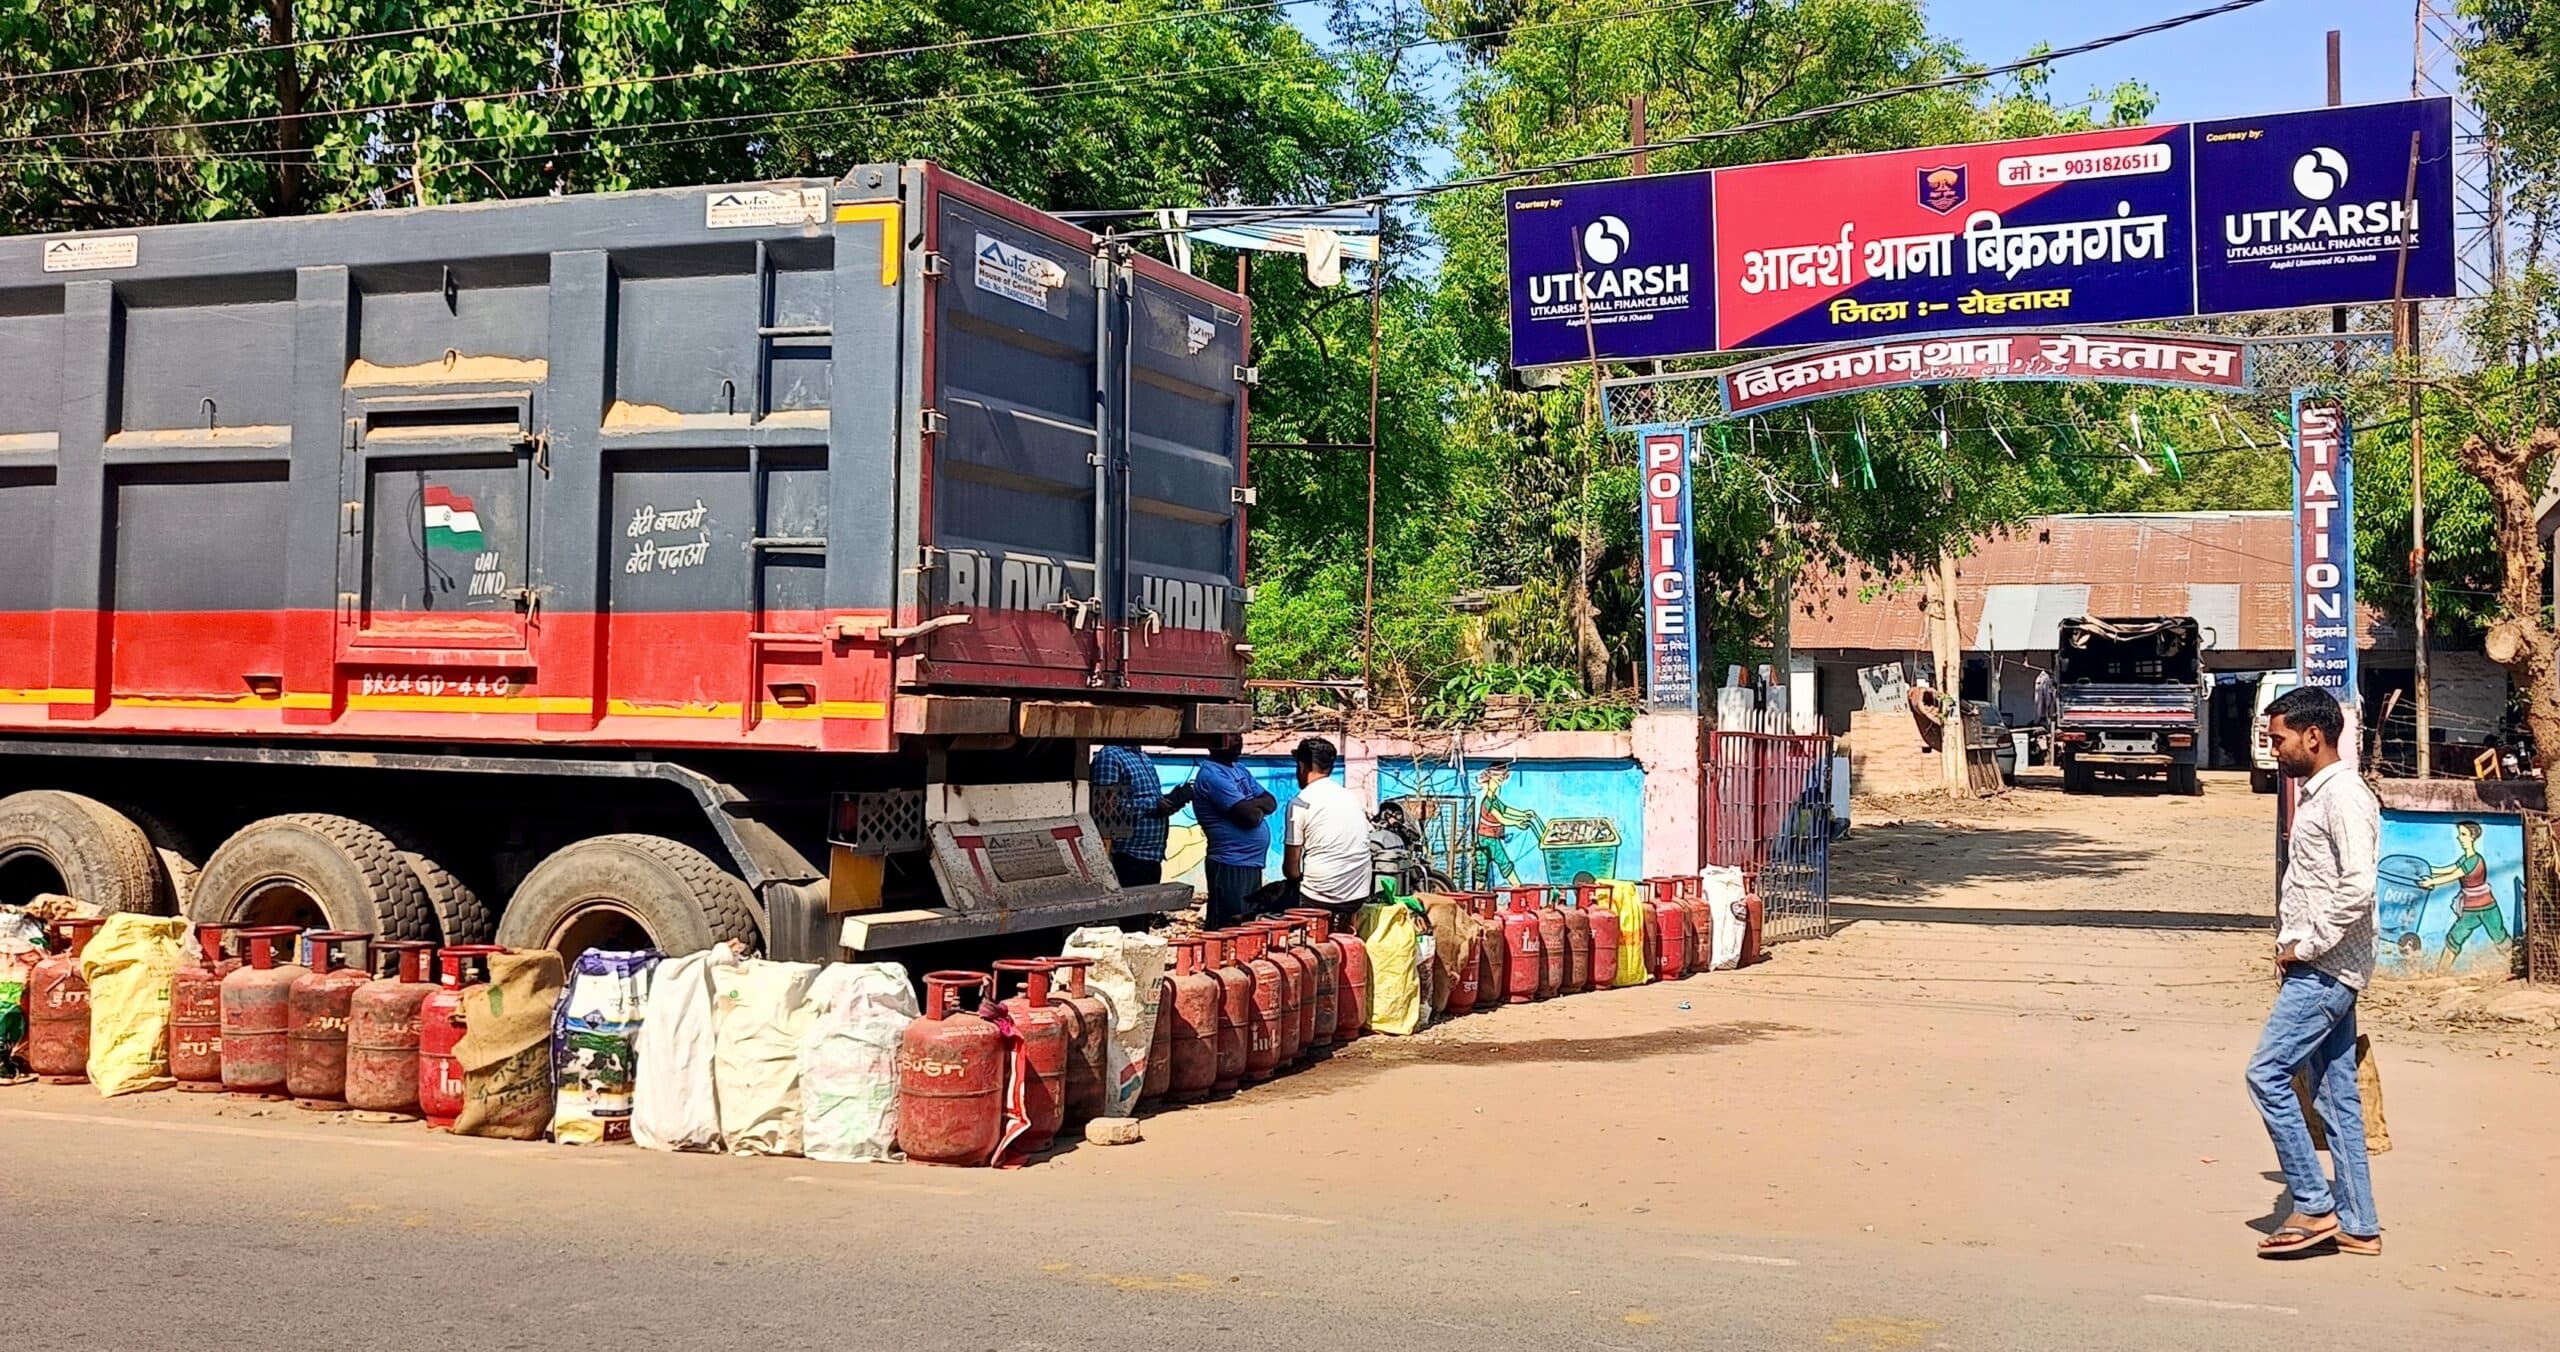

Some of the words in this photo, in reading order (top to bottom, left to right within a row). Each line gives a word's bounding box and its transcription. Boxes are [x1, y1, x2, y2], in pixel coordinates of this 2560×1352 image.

[2008, 155, 2033, 181] मो
[2064, 152, 2159, 177] 9031826511
[2225, 200, 2419, 245] UTKARSH
[980, 242, 1028, 273] Auto
[1740, 222, 1855, 294] आदर्श
[1864, 232, 1952, 281] थाना
[1965, 199, 2168, 283] बिक्रमगंज
[2226, 245, 2283, 258] UTKARSH
[2285, 241, 2326, 254] SMALL
[2328, 236, 2381, 250] FINANCE
[2384, 232, 2419, 246] BAK
[979, 268, 1002, 283] House
[1002, 278, 1011, 286] of
[1012, 280, 1043, 298] Certified
[1010, 270, 1038, 287] House
[1529, 263, 1689, 304] UTKARSH
[1531, 303, 1577, 316] UTKARSH
[1614, 297, 1658, 310] FINANCE
[1660, 295, 1689, 306] BANK
[1829, 301, 1908, 325] जिला
[1958, 288, 2071, 316] रोहतास
[2036, 335, 2237, 377] रोहतास
[627, 505, 656, 538] बेटी
[654, 499, 708, 532] बचाओ
[2301, 406, 2341, 619] STATION
[625, 539, 656, 574] बेटी
[657, 533, 710, 575] पढ़ाओ
[1648, 442, 1686, 635] POLICE
[474, 552, 499, 572] JAI
[469, 571, 506, 597] HIND
[2305, 675, 2342, 687] 826511
[2384, 888, 2417, 905] DUST
